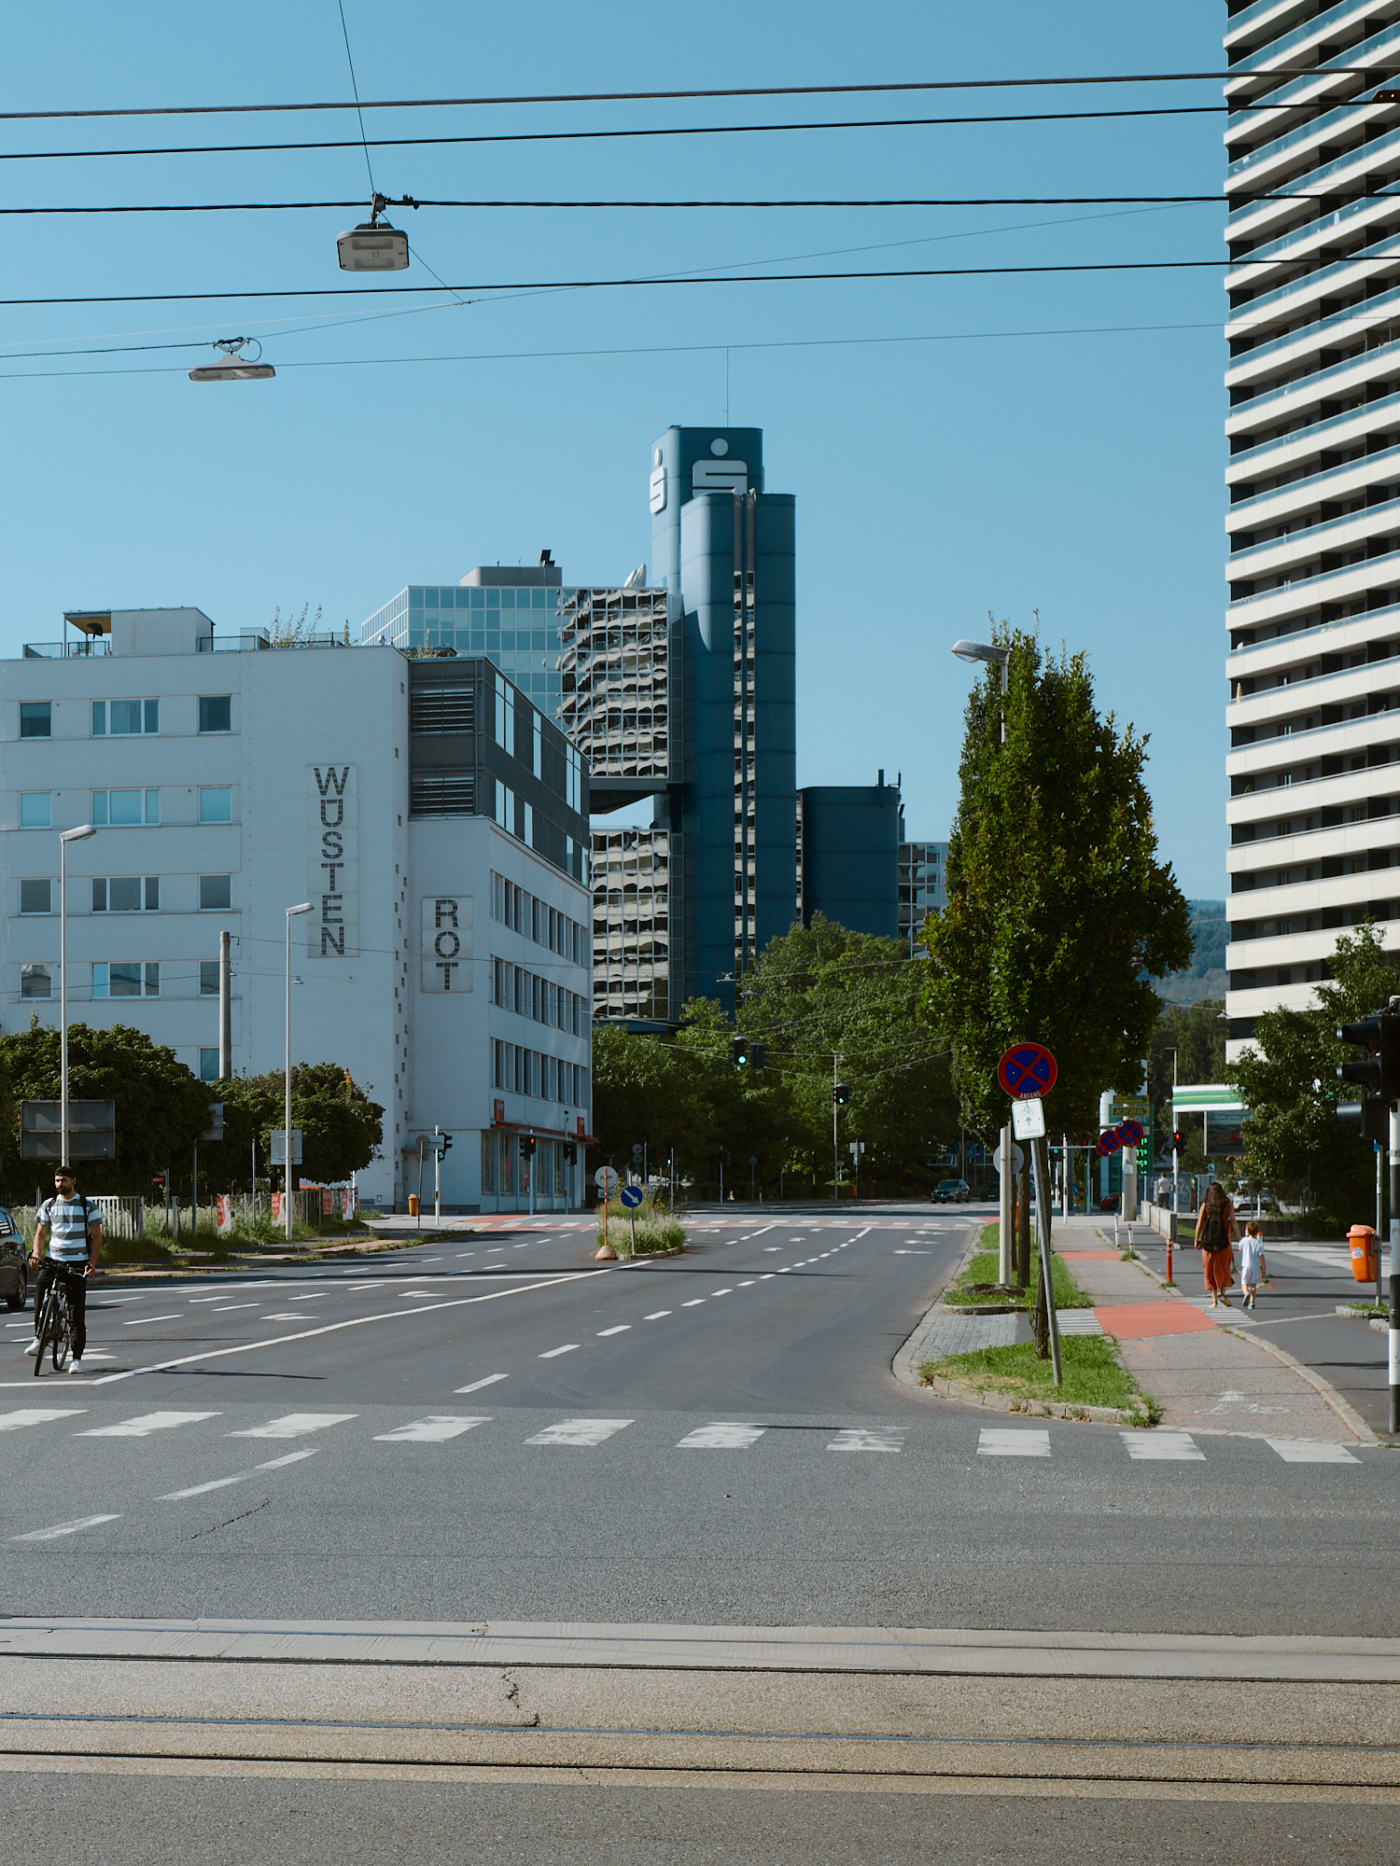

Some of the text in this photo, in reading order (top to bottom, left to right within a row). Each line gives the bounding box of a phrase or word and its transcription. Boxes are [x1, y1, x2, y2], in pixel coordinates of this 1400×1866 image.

[313, 766, 350, 956] WÜSTEN
[434, 899, 460, 991] ROT
[1020, 1090, 1041, 1099] ANFANG
